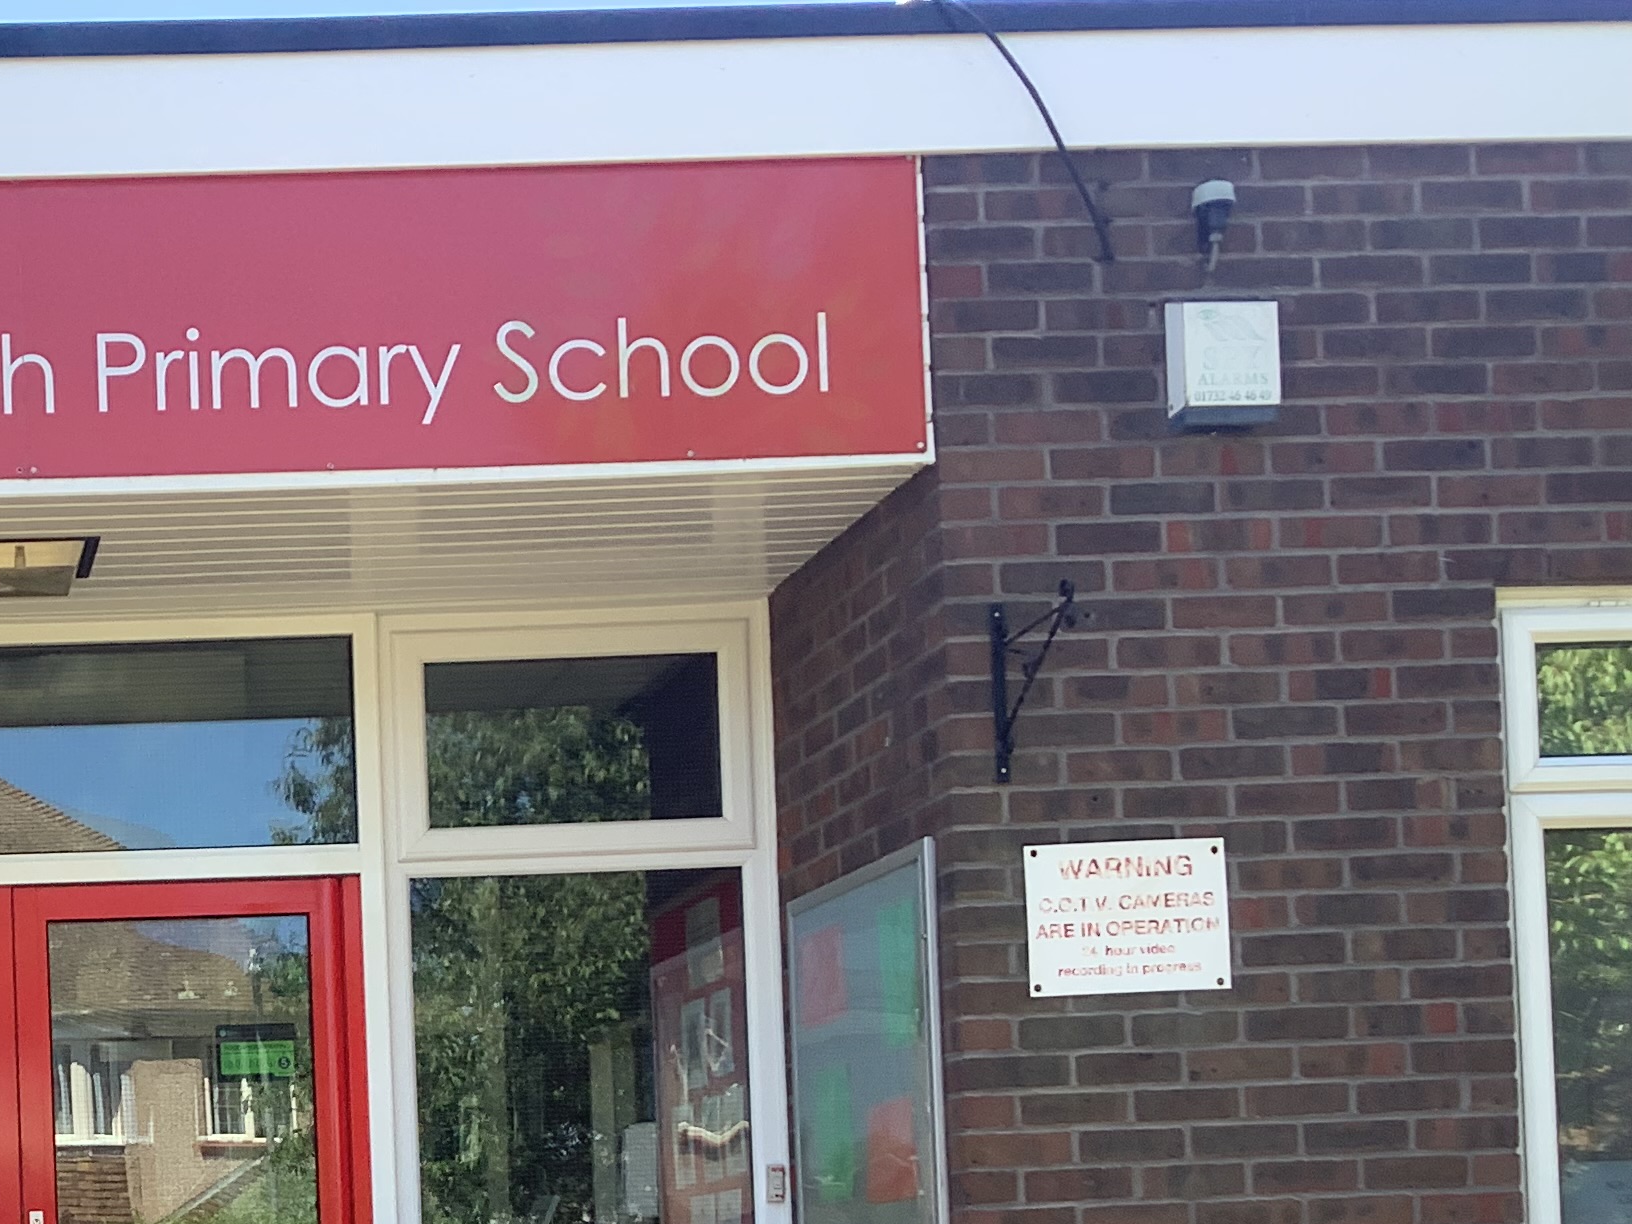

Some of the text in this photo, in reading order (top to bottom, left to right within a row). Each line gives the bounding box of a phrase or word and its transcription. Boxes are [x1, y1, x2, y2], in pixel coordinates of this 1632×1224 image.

[96, 327, 461, 425] Primary
[493, 311, 829, 403] School
[1197, 372, 1269, 385] ALARMS
[1059, 855, 1193, 880] WARNING
[1118, 891, 1215, 910] CAMERAS
[1036, 916, 1220, 940] ARE IN OPERATION
